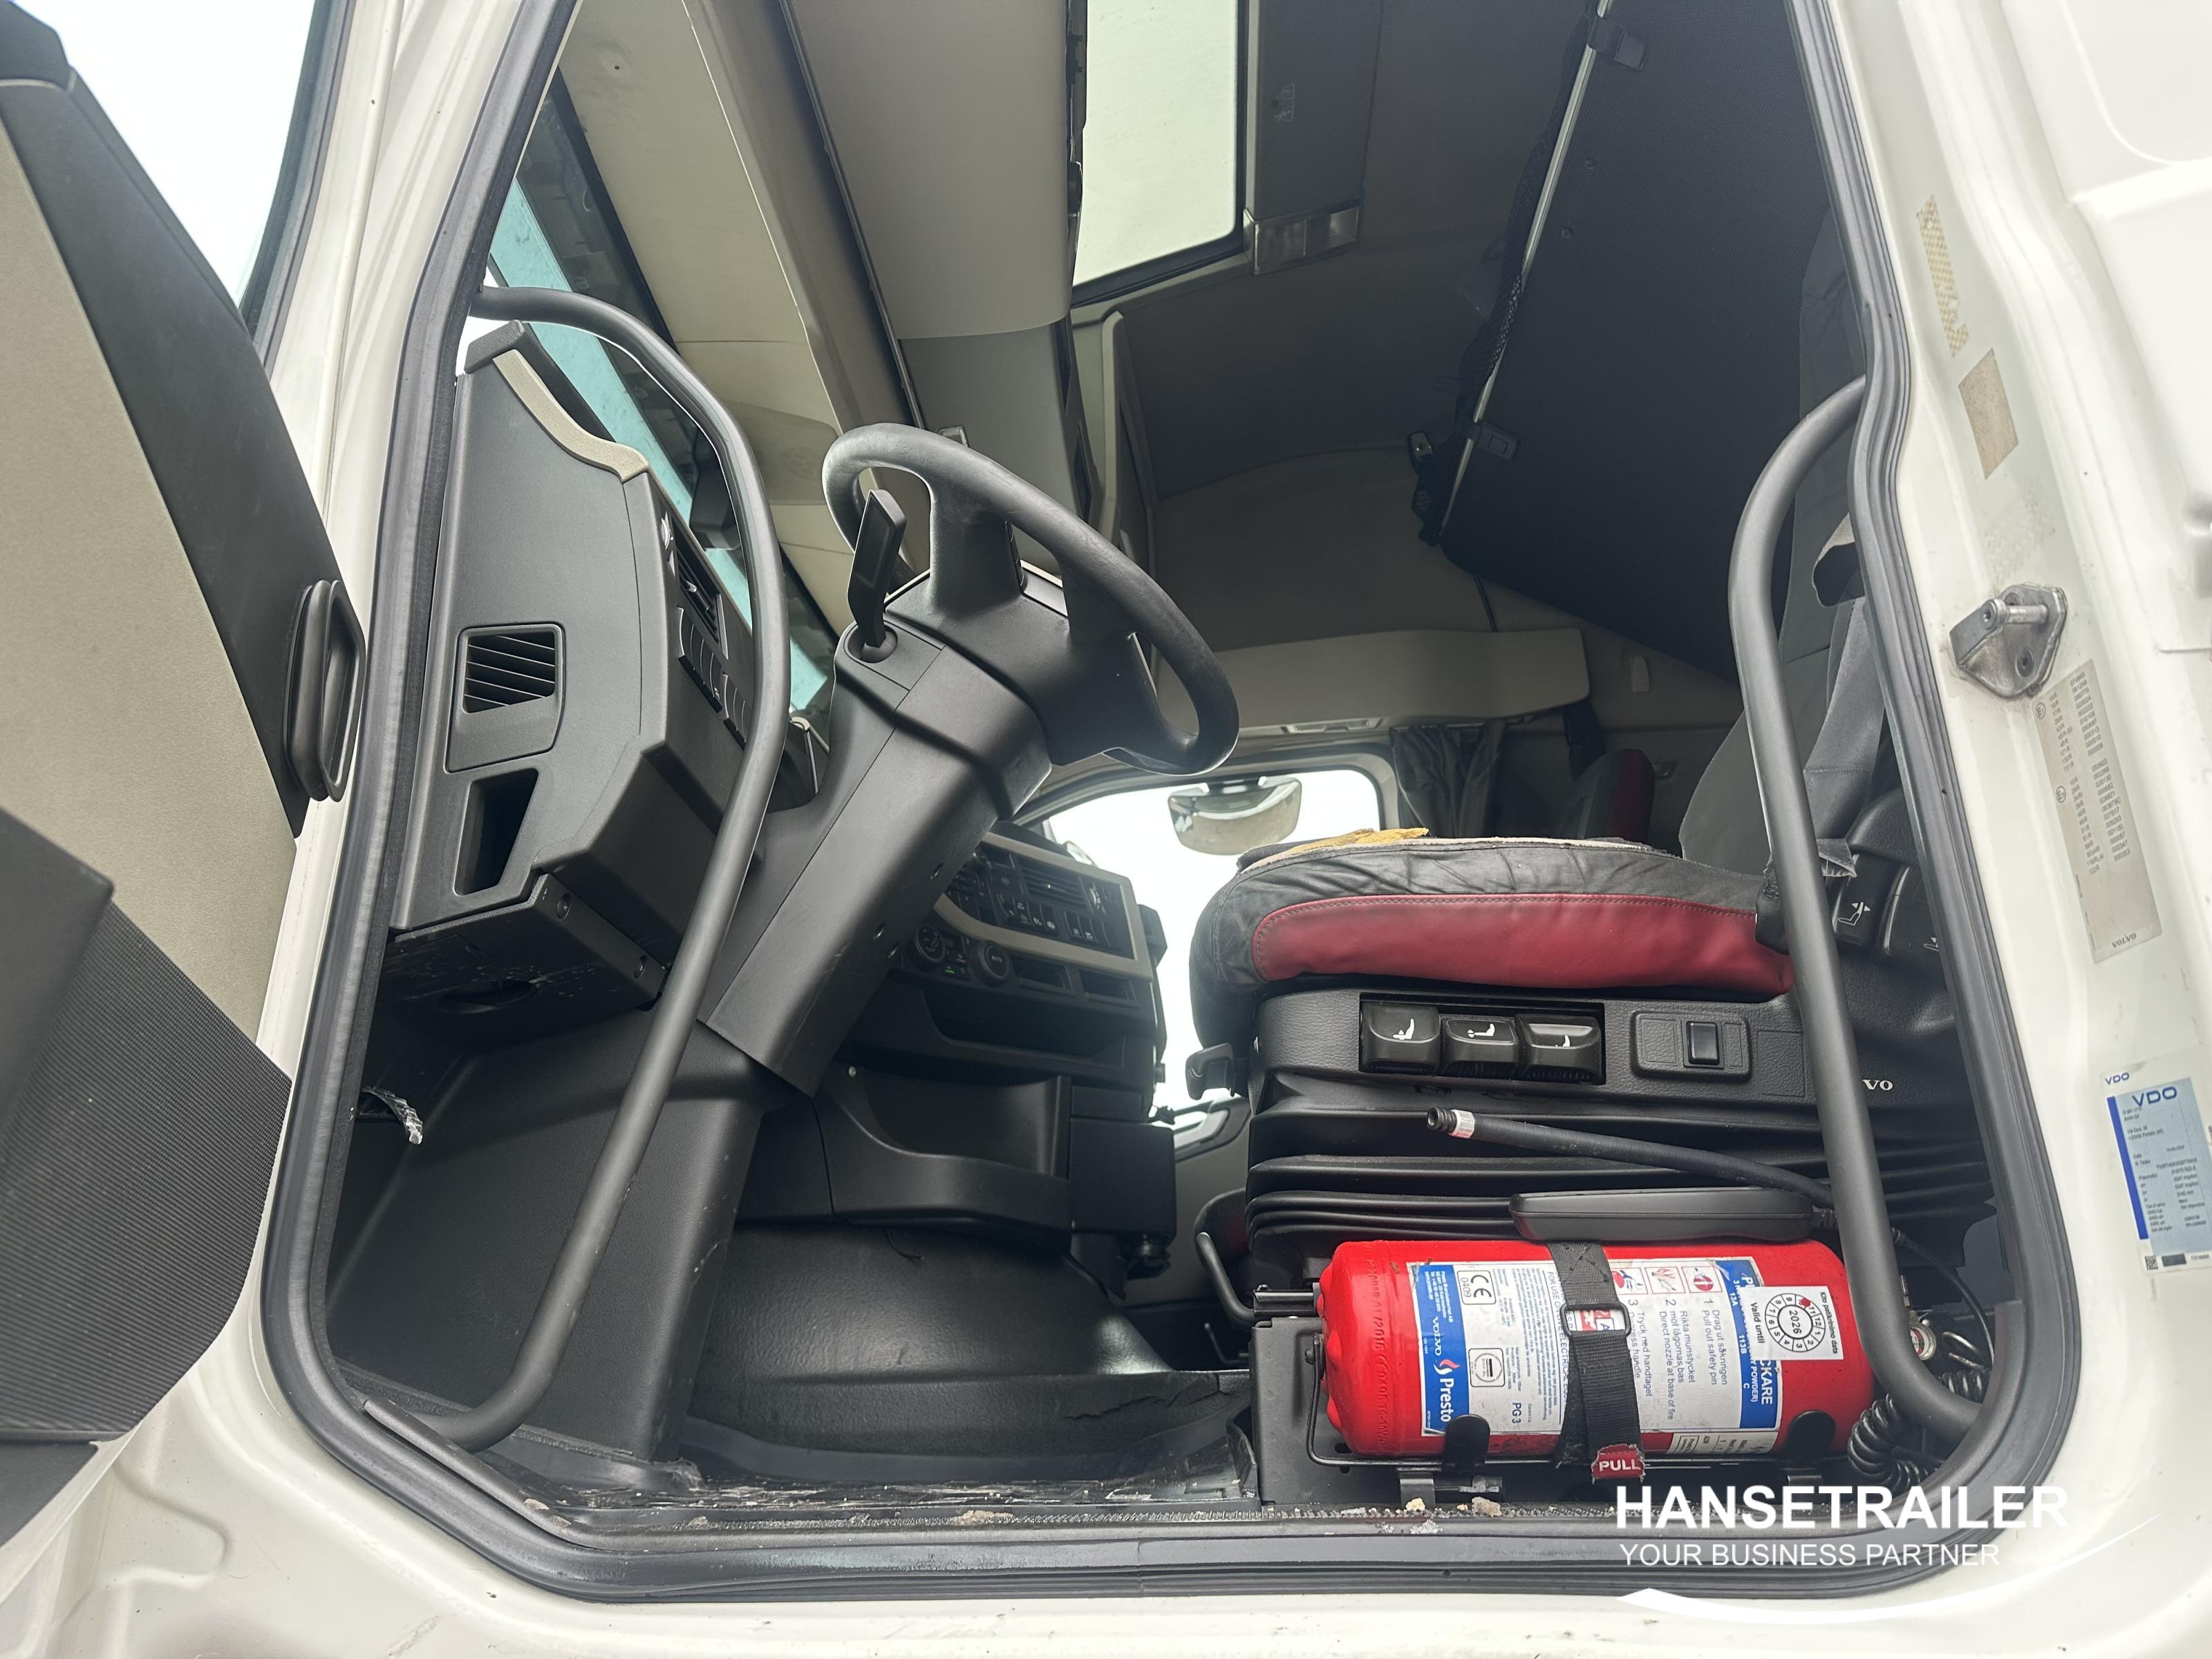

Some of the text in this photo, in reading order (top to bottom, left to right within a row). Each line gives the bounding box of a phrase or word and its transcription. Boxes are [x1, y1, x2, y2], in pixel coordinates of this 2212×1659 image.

[2112, 932, 2137, 948] VOLVO
[2105, 1072, 2130, 1085] VDO
[2132, 1086, 2177, 1106] VDO
[1461, 1277, 1472, 1297] 0409
[1547, 1271, 1557, 1285] FOR
[1550, 1286, 1560, 1300] USE
[1636, 1311, 1649, 1334] Tryck
[1659, 1311, 1671, 1336] Direct
[1712, 1309, 1723, 1331] Drag
[1729, 1291, 1738, 1306] 13A
[1738, 1334, 1747, 1354] 113B
[1750, 1302, 1765, 1344] Valid until
[1789, 1310, 1801, 1335] 2026
[1432, 1315, 1442, 1356] VOLVO
[1640, 1335, 1651, 1353] ned
[1716, 1332, 1725, 1341] ut
[1663, 1338, 1674, 1366] nozzle
[1669, 1311, 1678, 1327] mot
[1677, 1367, 1685, 1383] bas
[1679, 1311, 1696, 1383] Rikta munstycket
[1701, 1310, 1718, 1385] Pull out safety pin
[1632, 1349, 1642, 1379] handle
[1666, 1367, 1674, 1376] at
[1643, 1354, 1653, 1397] handtaget
[1439, 1378, 1455, 1423] Presto
[1512, 1403, 1521, 1416] PG
[1667, 1399, 1676, 1407] of
[1667, 1407, 1676, 1421] fire
[1599, 1459, 1641, 1472] PULL
